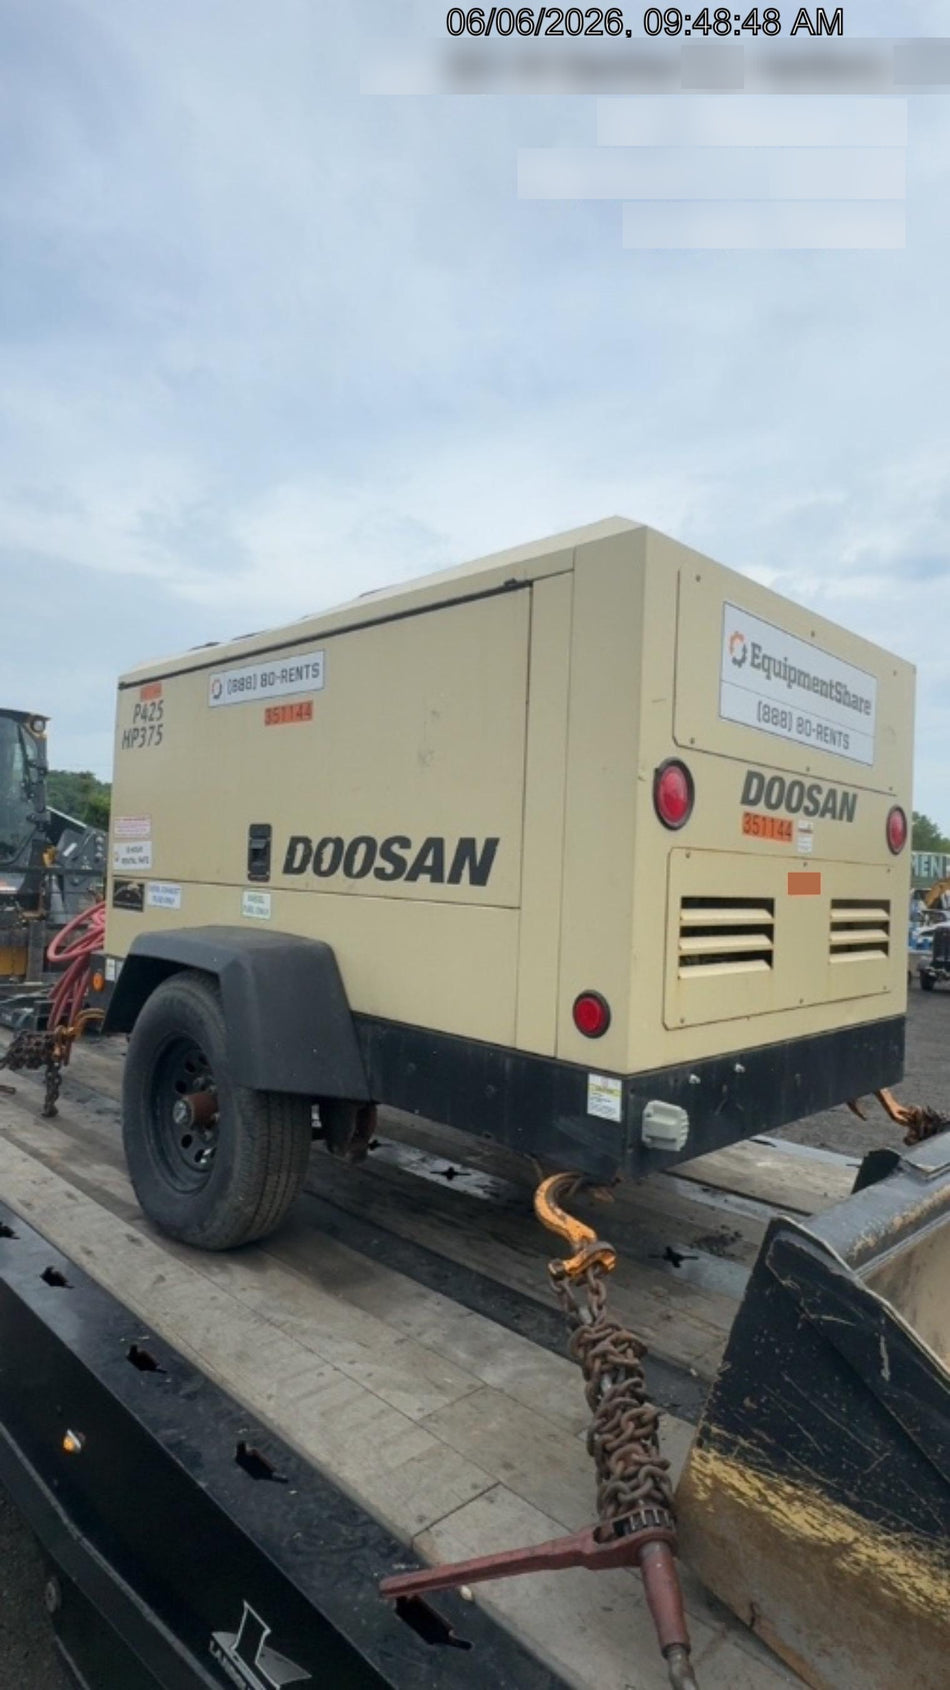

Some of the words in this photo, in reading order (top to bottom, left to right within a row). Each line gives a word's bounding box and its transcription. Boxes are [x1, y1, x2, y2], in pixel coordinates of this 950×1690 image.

[227, 673, 257, 695] (888)
[260, 662, 320, 688] 80-RENTS
[750, 642, 872, 716] EquipmentShare
[133, 700, 164, 724] P425
[264, 702, 313, 726] 351144
[757, 700, 793, 732] (888)
[796, 716, 850, 750] 80-RENTS
[122, 724, 164, 750] HP375
[740, 770, 858, 823] DOOSAN
[743, 812, 792, 842] 351144
[282, 835, 500, 887] DOOSAN
